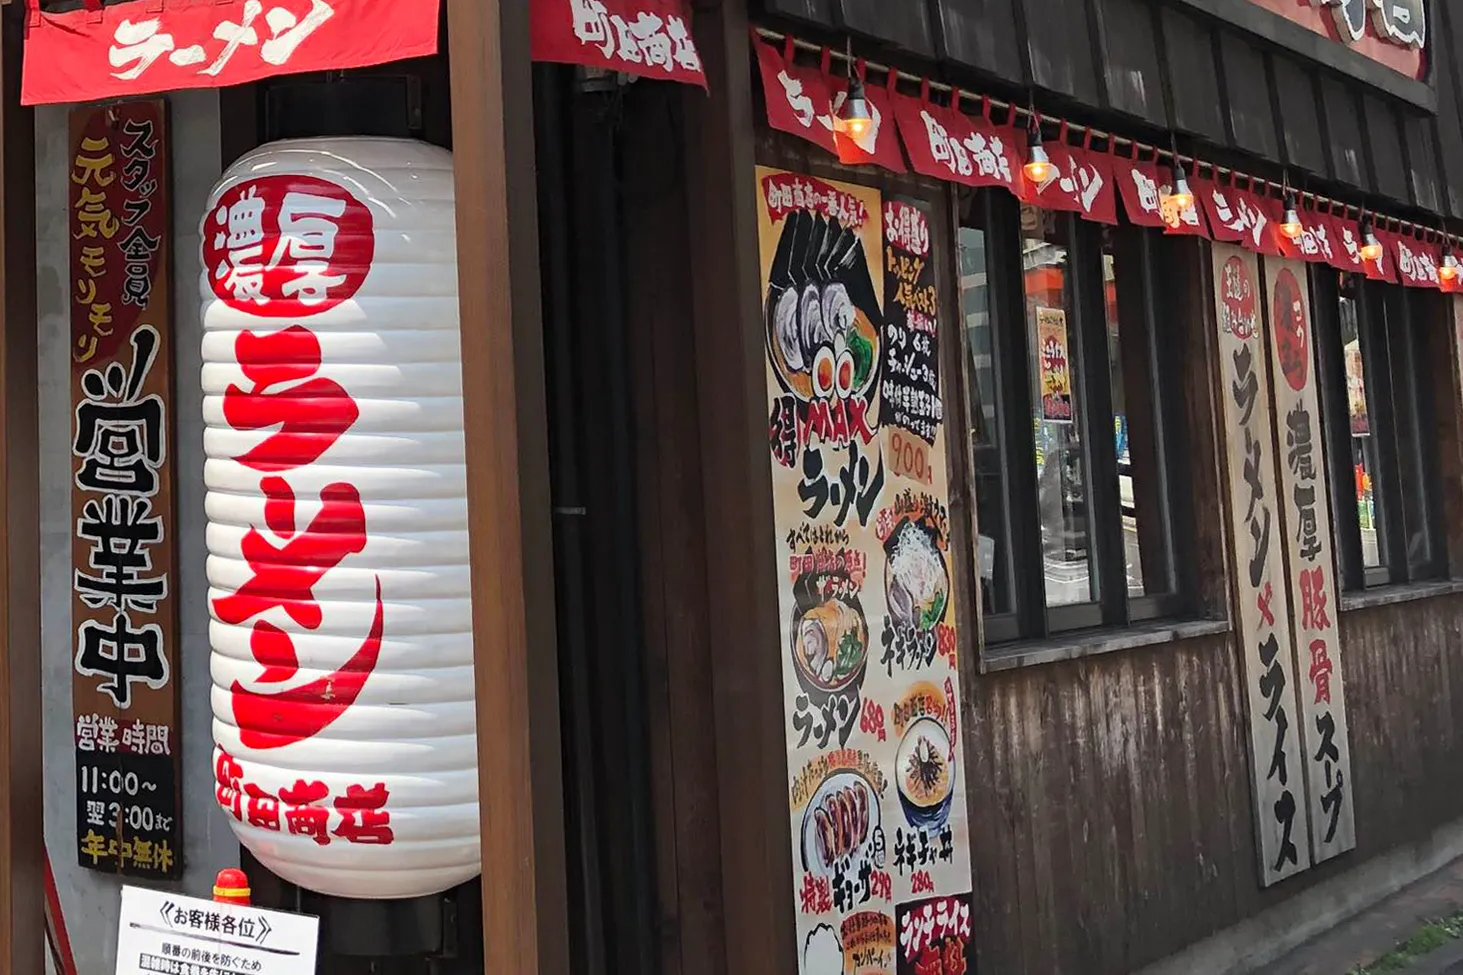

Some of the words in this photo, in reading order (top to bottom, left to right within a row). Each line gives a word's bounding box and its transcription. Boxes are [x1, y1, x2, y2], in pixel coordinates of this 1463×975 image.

[777, 70, 882, 155] ラーン
[920, 110, 1012, 183] 町田商店
[72, 136, 120, 363] 元気モリモリ
[117, 118, 161, 311] スタッフ全員
[214, 184, 347, 307] 濃厚
[804, 398, 877, 445] MAX
[72, 324, 170, 710] 営業中
[798, 440, 884, 528] ラーメン
[214, 324, 384, 751] ラーメン
[1286, 398, 1343, 843] 濃厚豚骨スープ
[77, 712, 171, 756] 営業時間
[793, 693, 861, 749] ラーメン
[216, 743, 394, 845] 町田商店
[81, 828, 174, 873] 年中無休
[161, 942, 262, 971] 順番の前後を防ぐため
[900, 899, 971, 958] ランチライス
